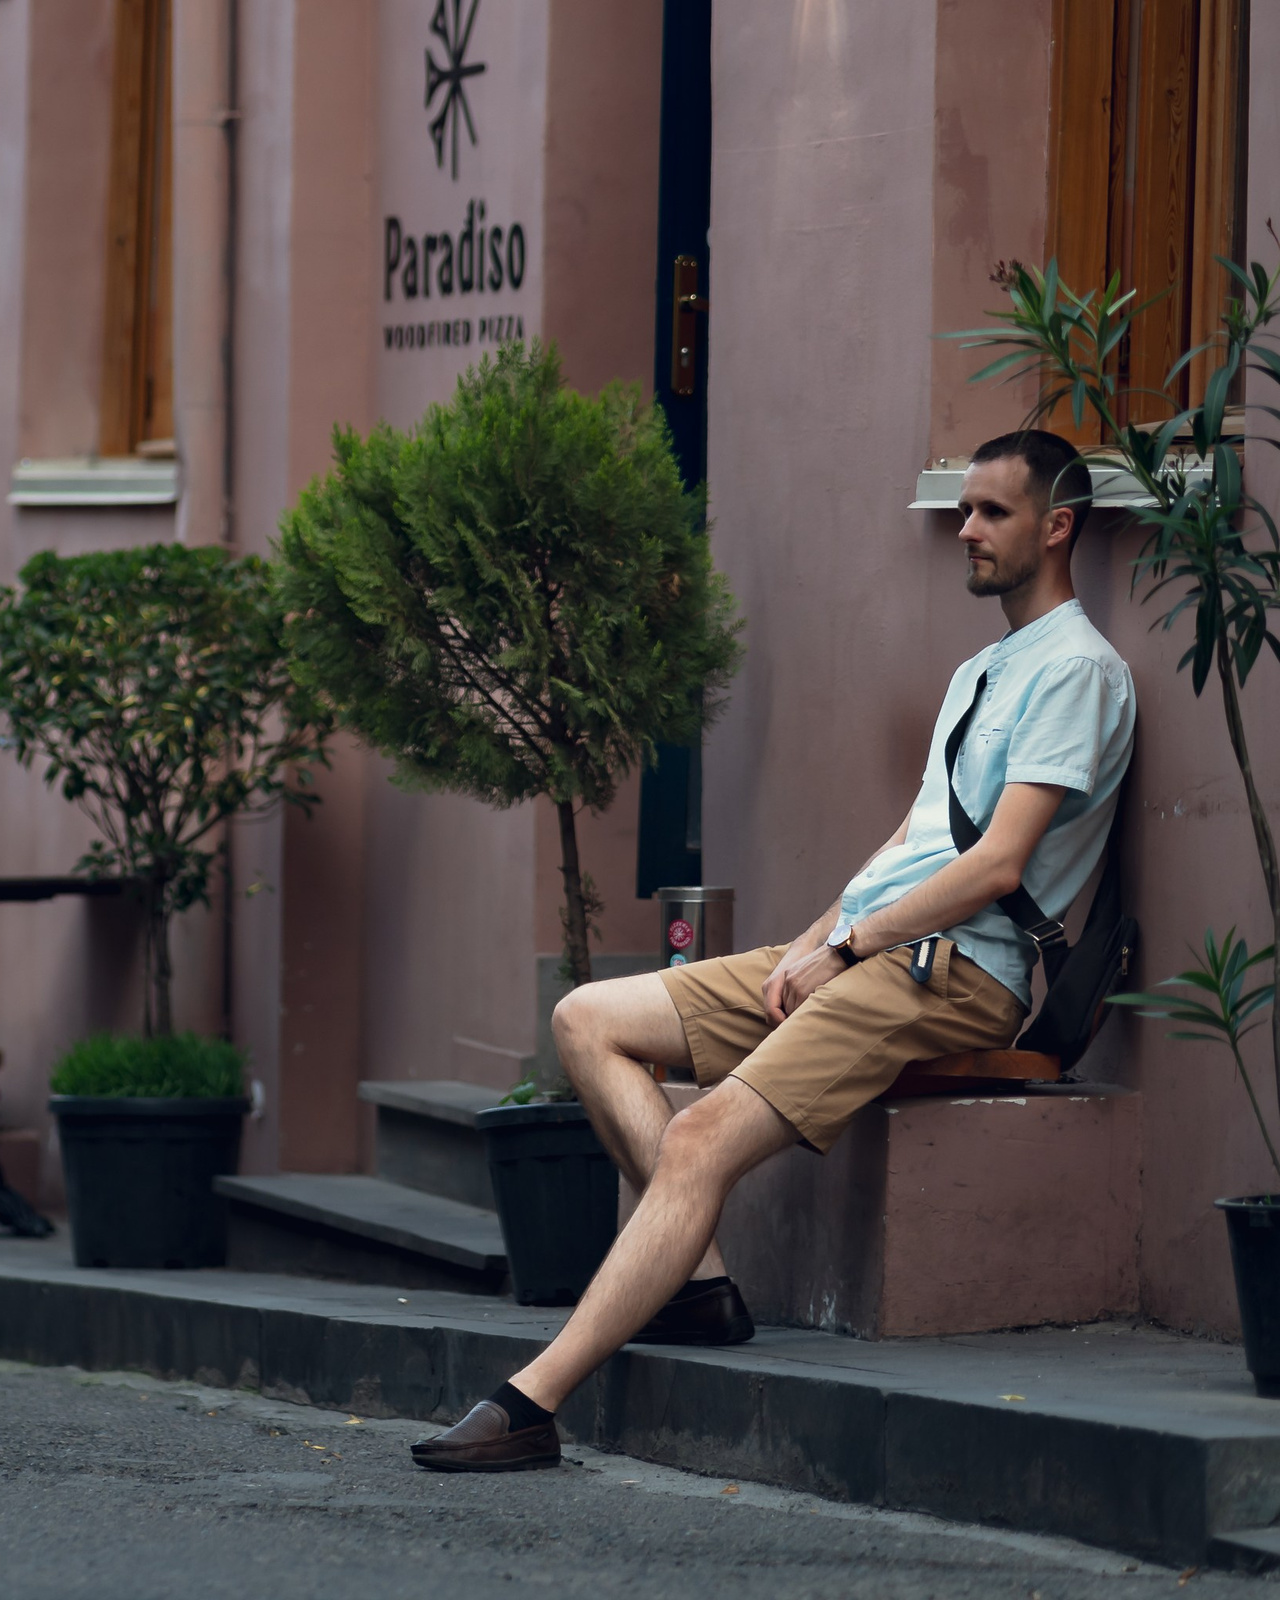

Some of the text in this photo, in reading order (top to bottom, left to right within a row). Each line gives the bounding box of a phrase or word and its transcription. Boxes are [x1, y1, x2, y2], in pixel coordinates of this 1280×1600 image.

[385, 198, 525, 302] Paradiso
[384, 315, 525, 351] WOODFIRED PIZZA
